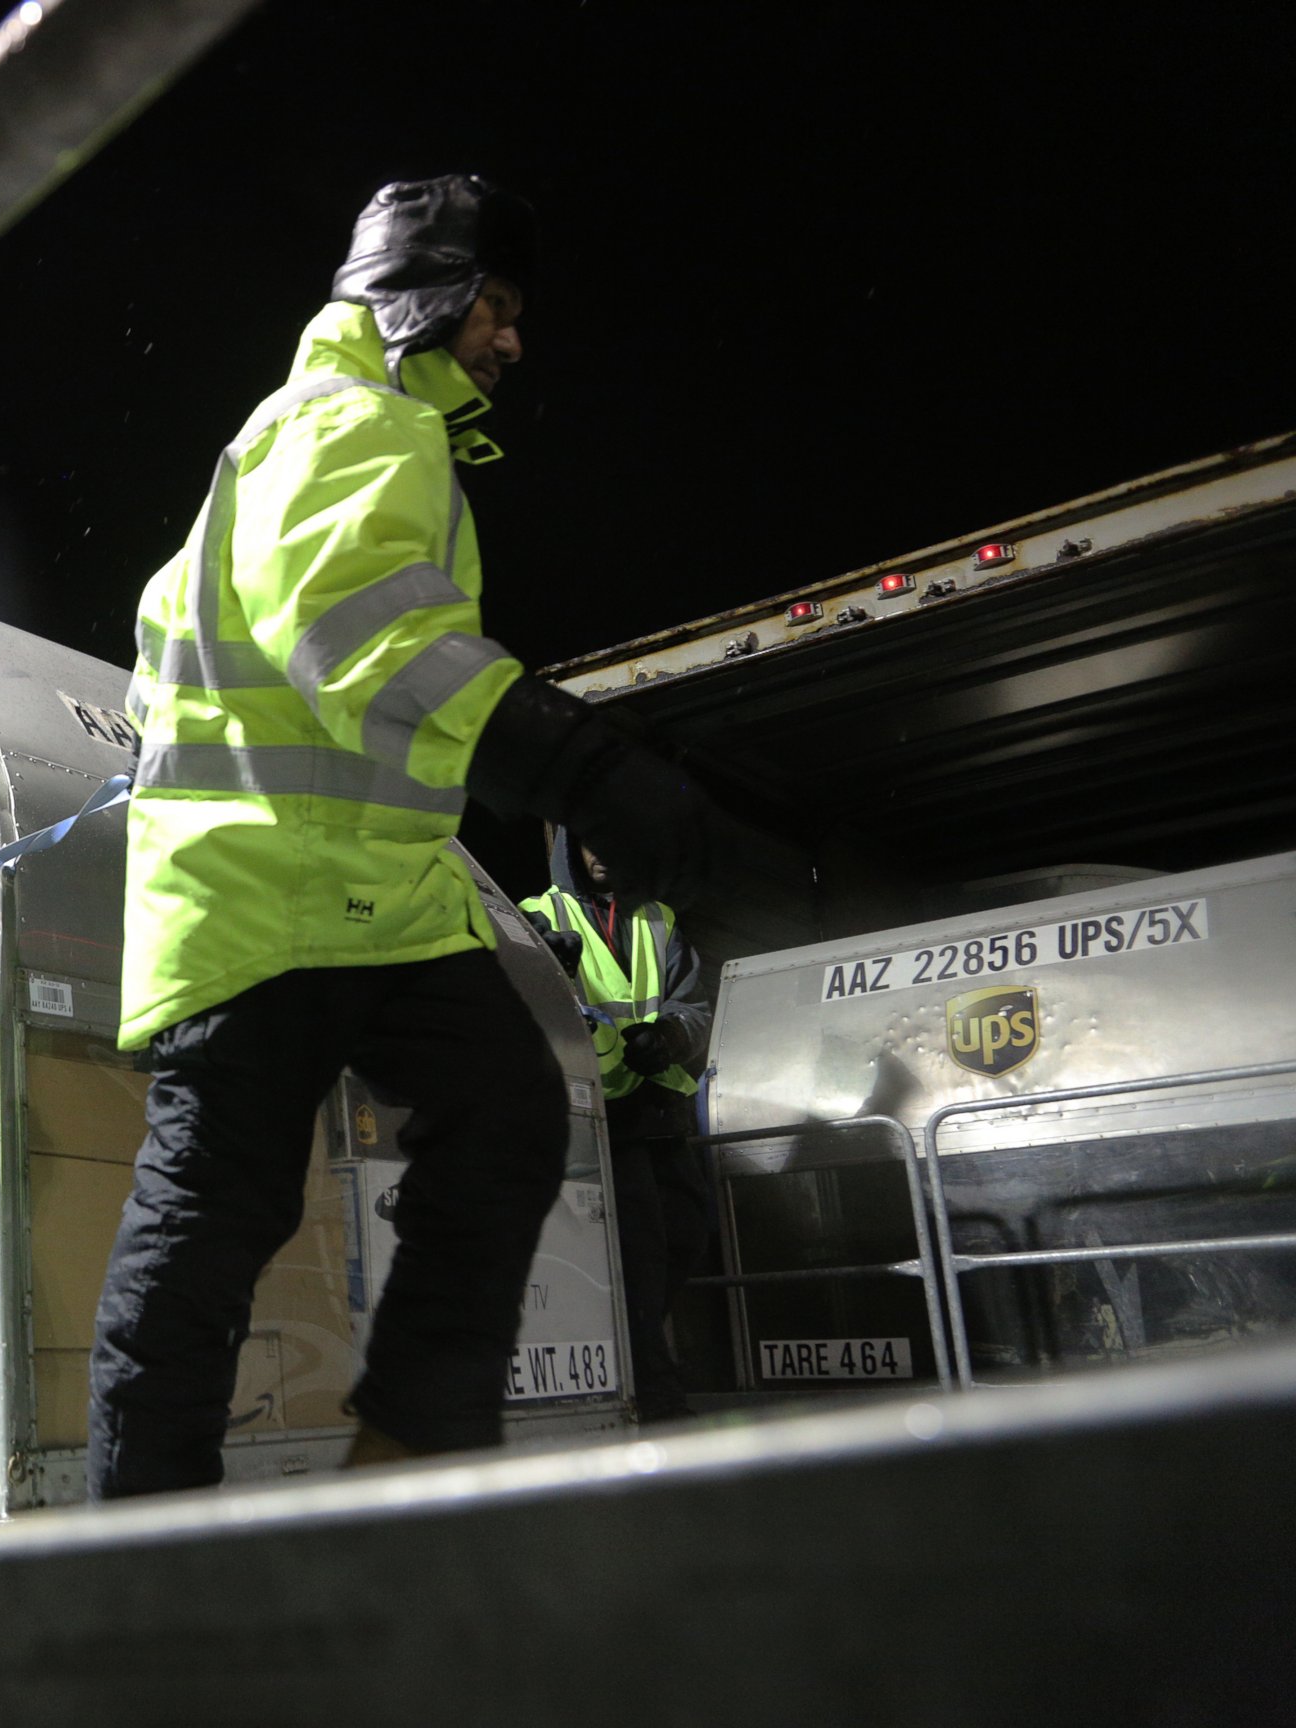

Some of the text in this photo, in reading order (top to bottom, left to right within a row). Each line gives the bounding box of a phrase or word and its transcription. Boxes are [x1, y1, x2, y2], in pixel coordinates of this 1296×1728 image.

[346, 898, 374, 917] HH
[826, 902, 1201, 999] AAZ 22856 UPS/5X
[954, 1011, 1034, 1065] ups
[531, 1284, 549, 1310] TV
[528, 1346, 564, 1393] WT.
[569, 1344, 608, 1390] 483
[764, 1341, 898, 1376] TARE 464
